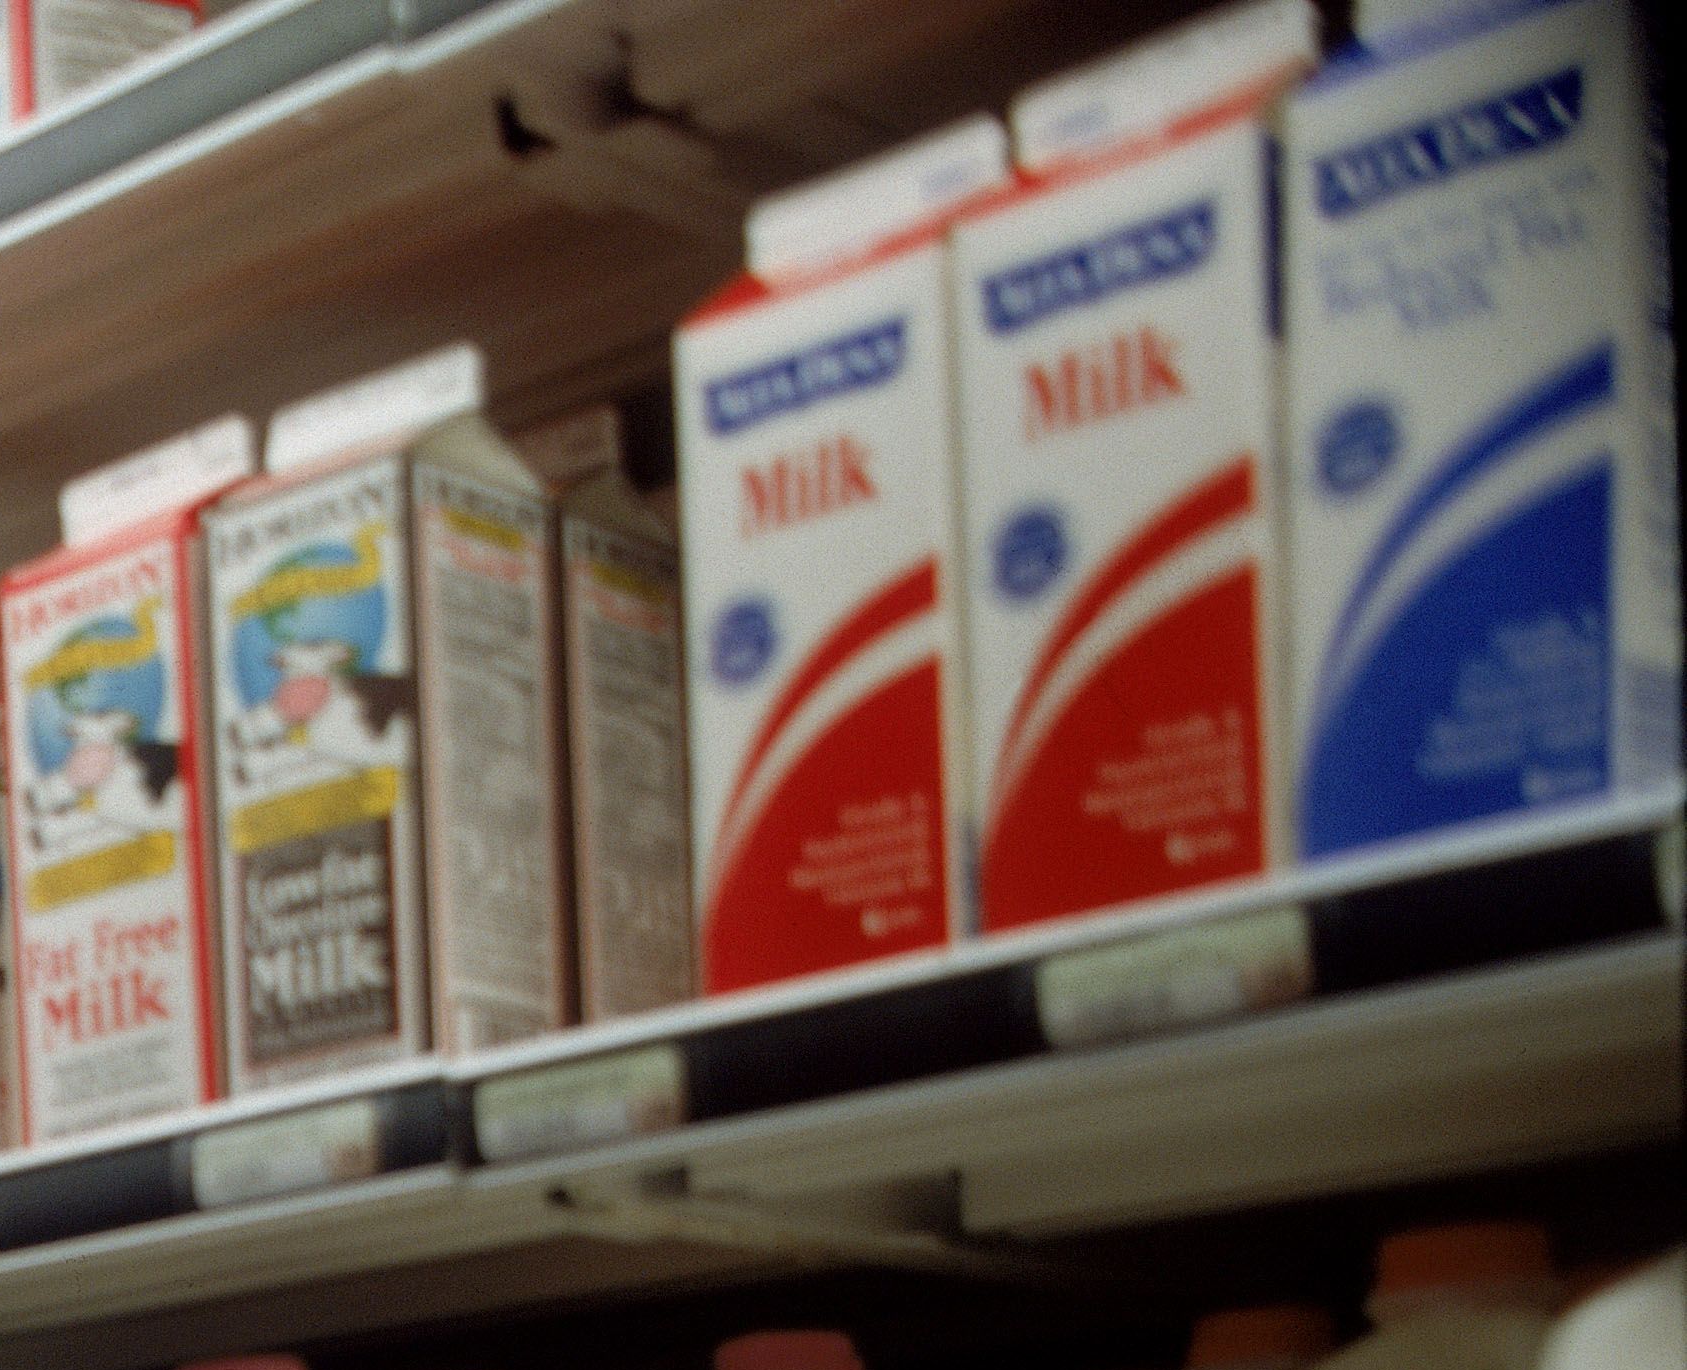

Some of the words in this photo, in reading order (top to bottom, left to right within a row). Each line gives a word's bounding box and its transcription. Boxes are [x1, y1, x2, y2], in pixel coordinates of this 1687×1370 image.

[1025, 325, 1187, 440] Milk
[739, 432, 880, 536] Milk
[42, 966, 172, 1048] Milk
